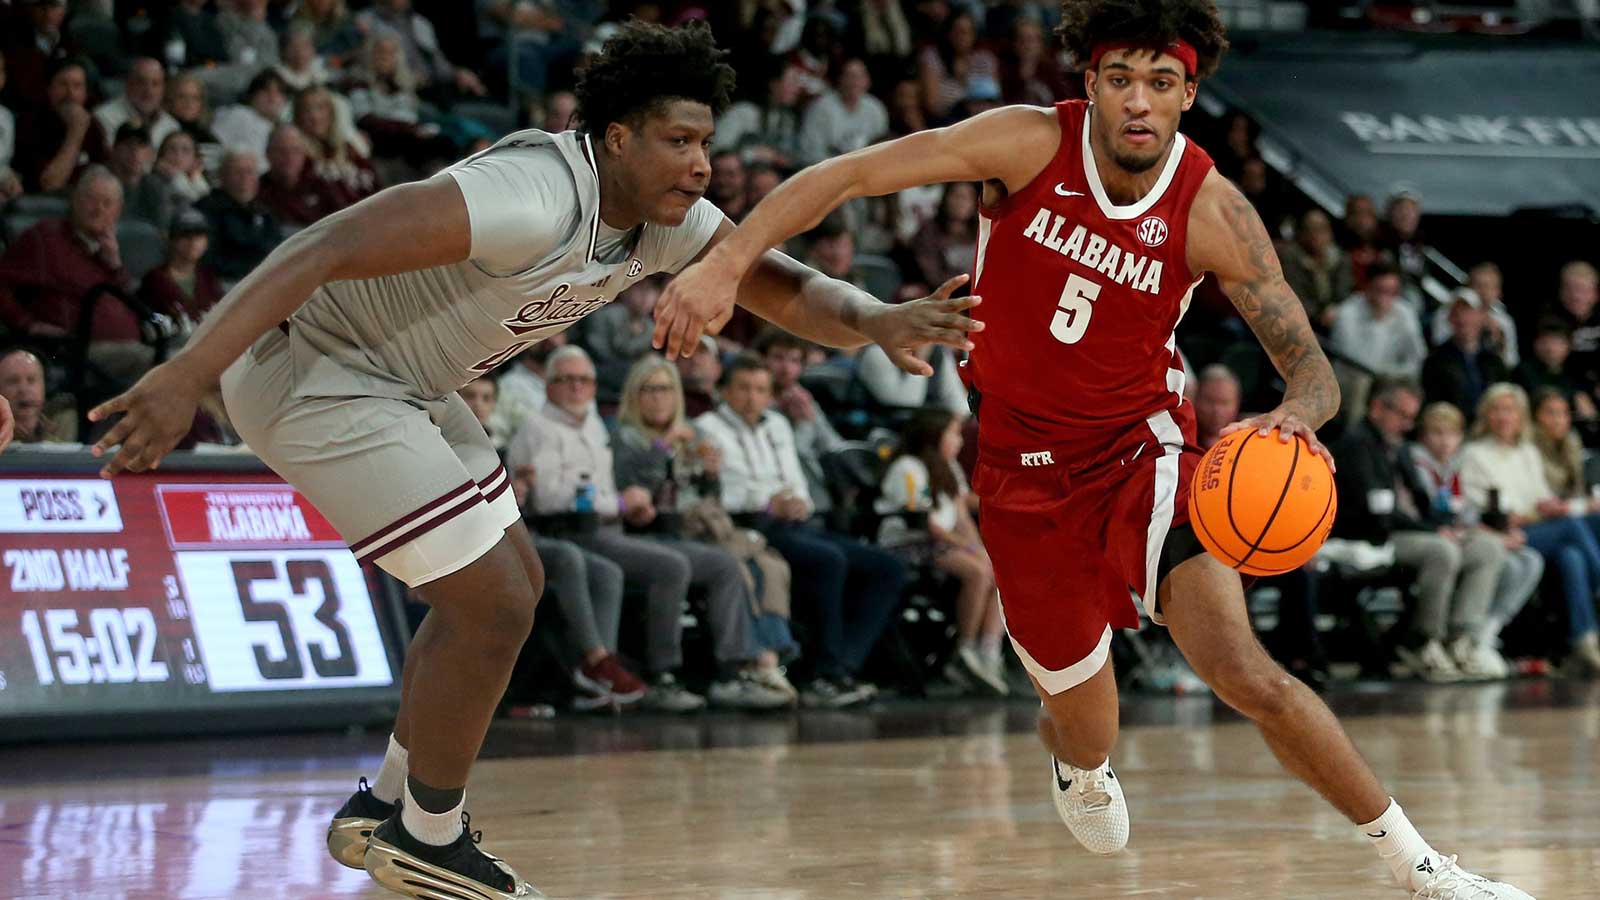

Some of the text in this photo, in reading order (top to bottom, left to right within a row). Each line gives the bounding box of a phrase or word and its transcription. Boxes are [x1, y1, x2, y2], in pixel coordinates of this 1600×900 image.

[1023, 208, 1163, 294] ALABAMA
[1138, 217, 1167, 245] SEC
[626, 258, 643, 277] EC
[1049, 273, 1102, 344] 5
[1021, 451, 1054, 466] RTR
[1207, 439, 1235, 490] STATE
[20, 488, 86, 521] POSS
[206, 504, 312, 541] ALABAMA
[3, 548, 131, 592] 2ND HALF
[230, 559, 359, 679] 53
[21, 608, 170, 685] 15:02
